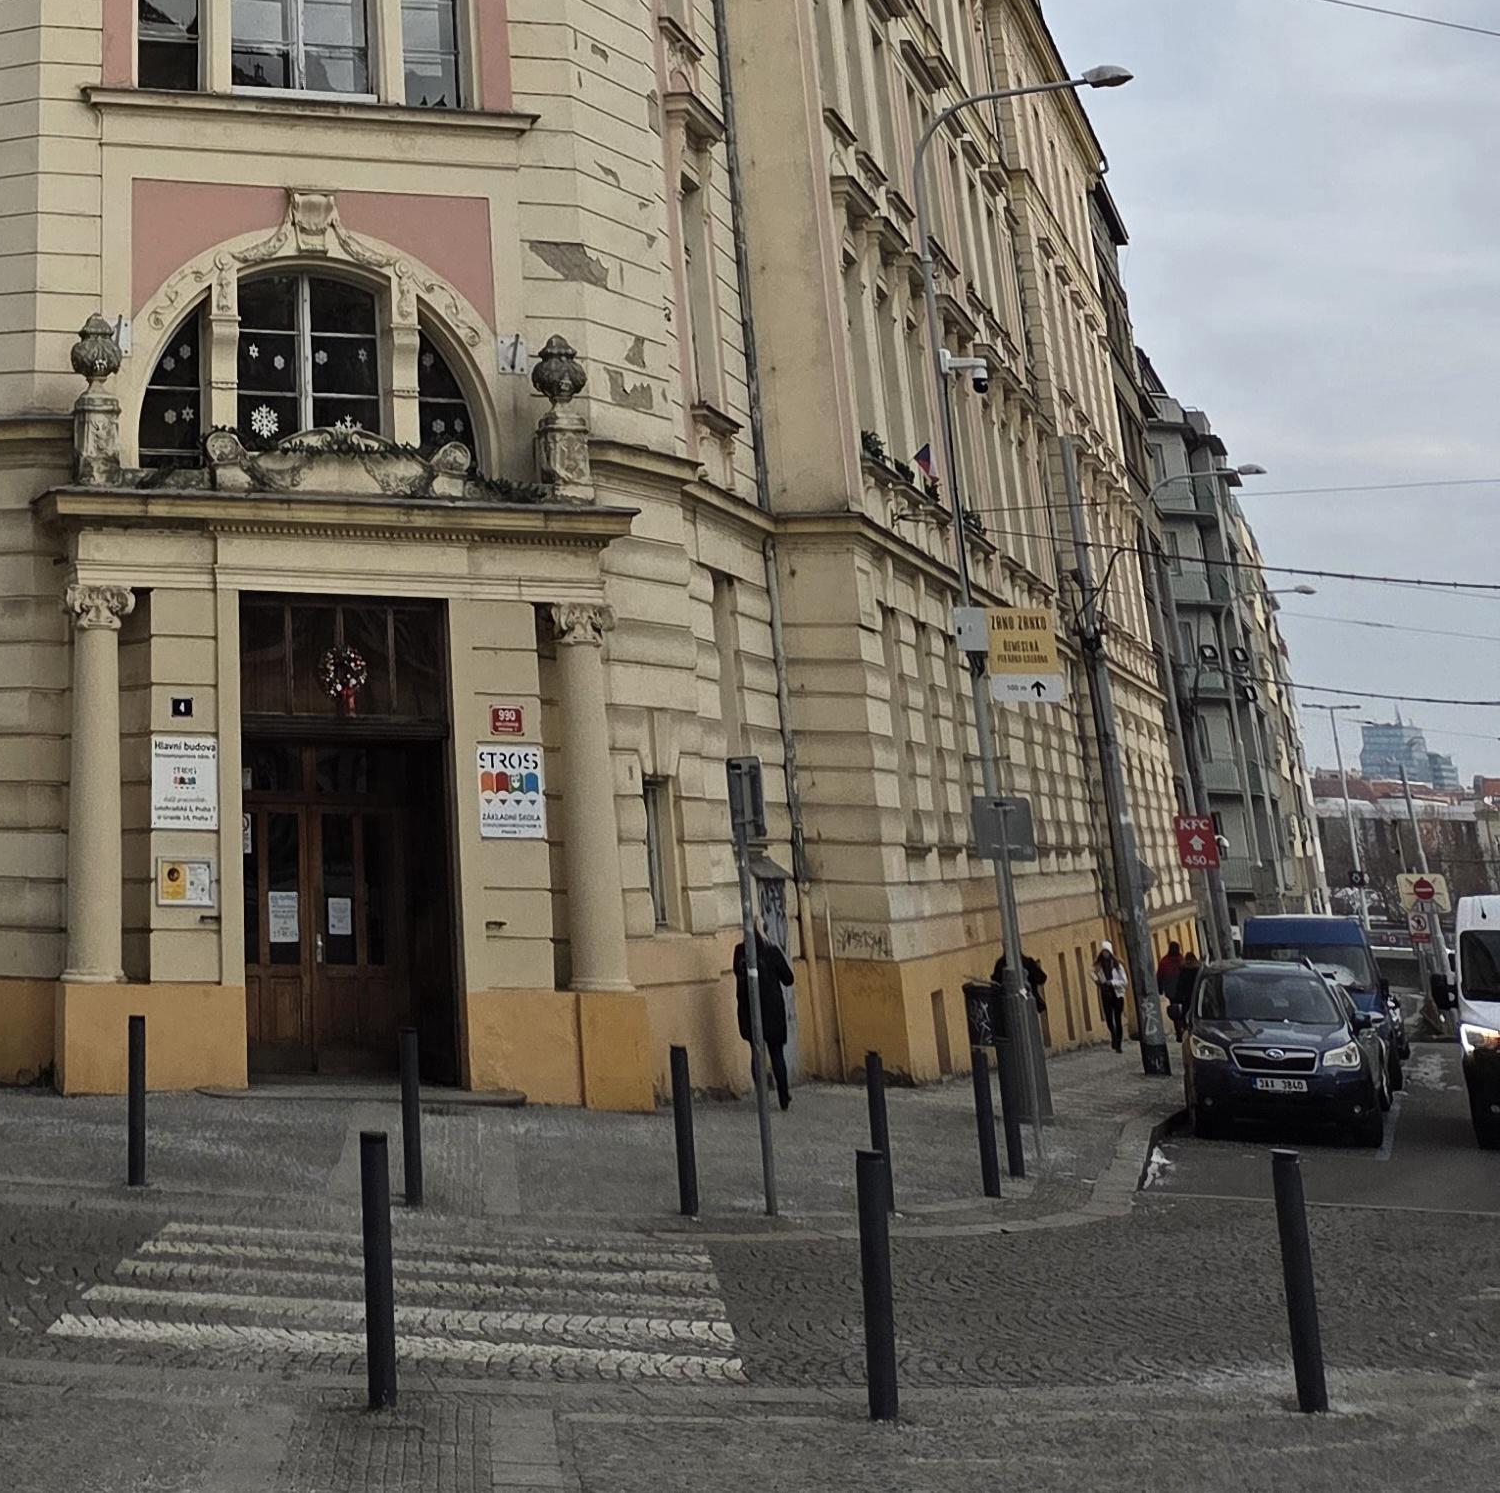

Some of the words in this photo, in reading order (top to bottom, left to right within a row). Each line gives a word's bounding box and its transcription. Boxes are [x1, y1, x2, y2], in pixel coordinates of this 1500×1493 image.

[183, 741, 217, 752] budova
[1180, 818, 1210, 831] KFC
[1184, 855, 1207, 866] 450
